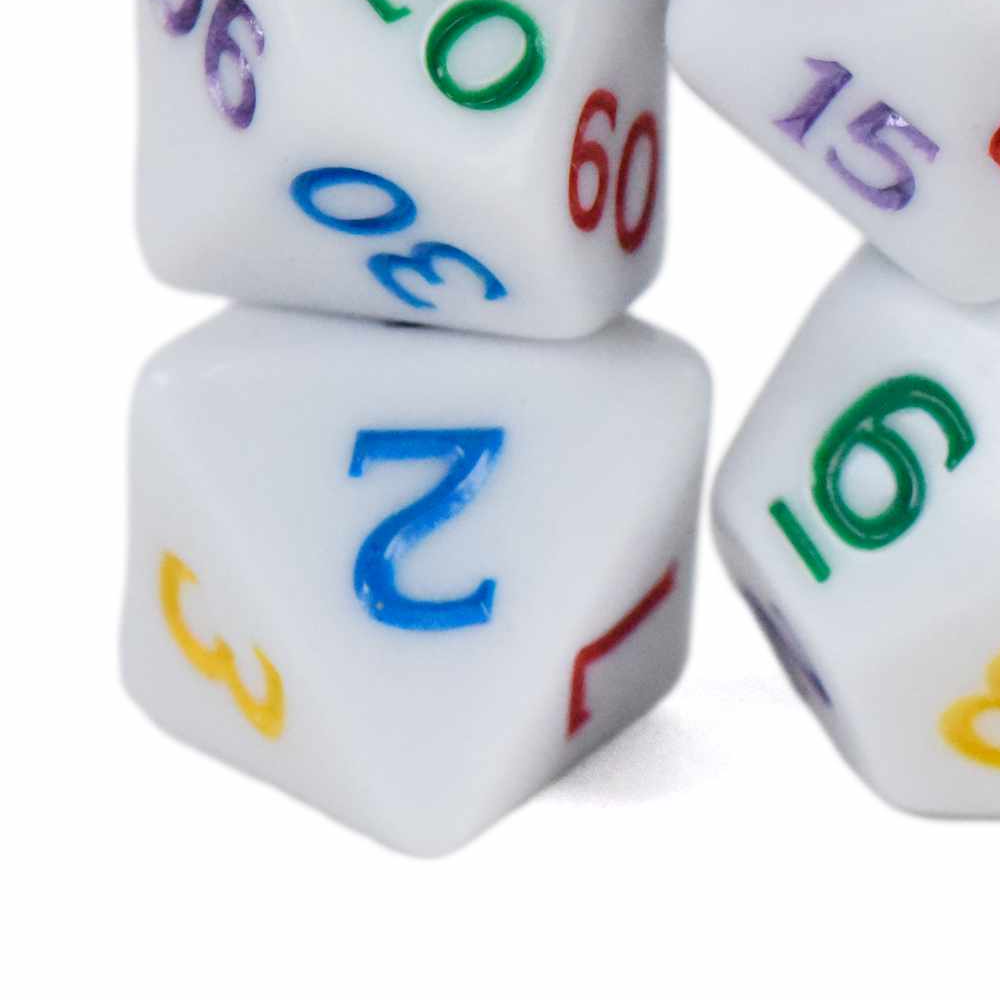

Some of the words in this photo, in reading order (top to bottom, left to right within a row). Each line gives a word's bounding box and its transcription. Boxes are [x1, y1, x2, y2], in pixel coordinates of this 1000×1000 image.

[566, 86, 661, 256] 60
[772, 56, 942, 214] 15
[288, 164, 509, 313] 30
[346, 425, 508, 633] 2
[157, 548, 287, 742] 3
